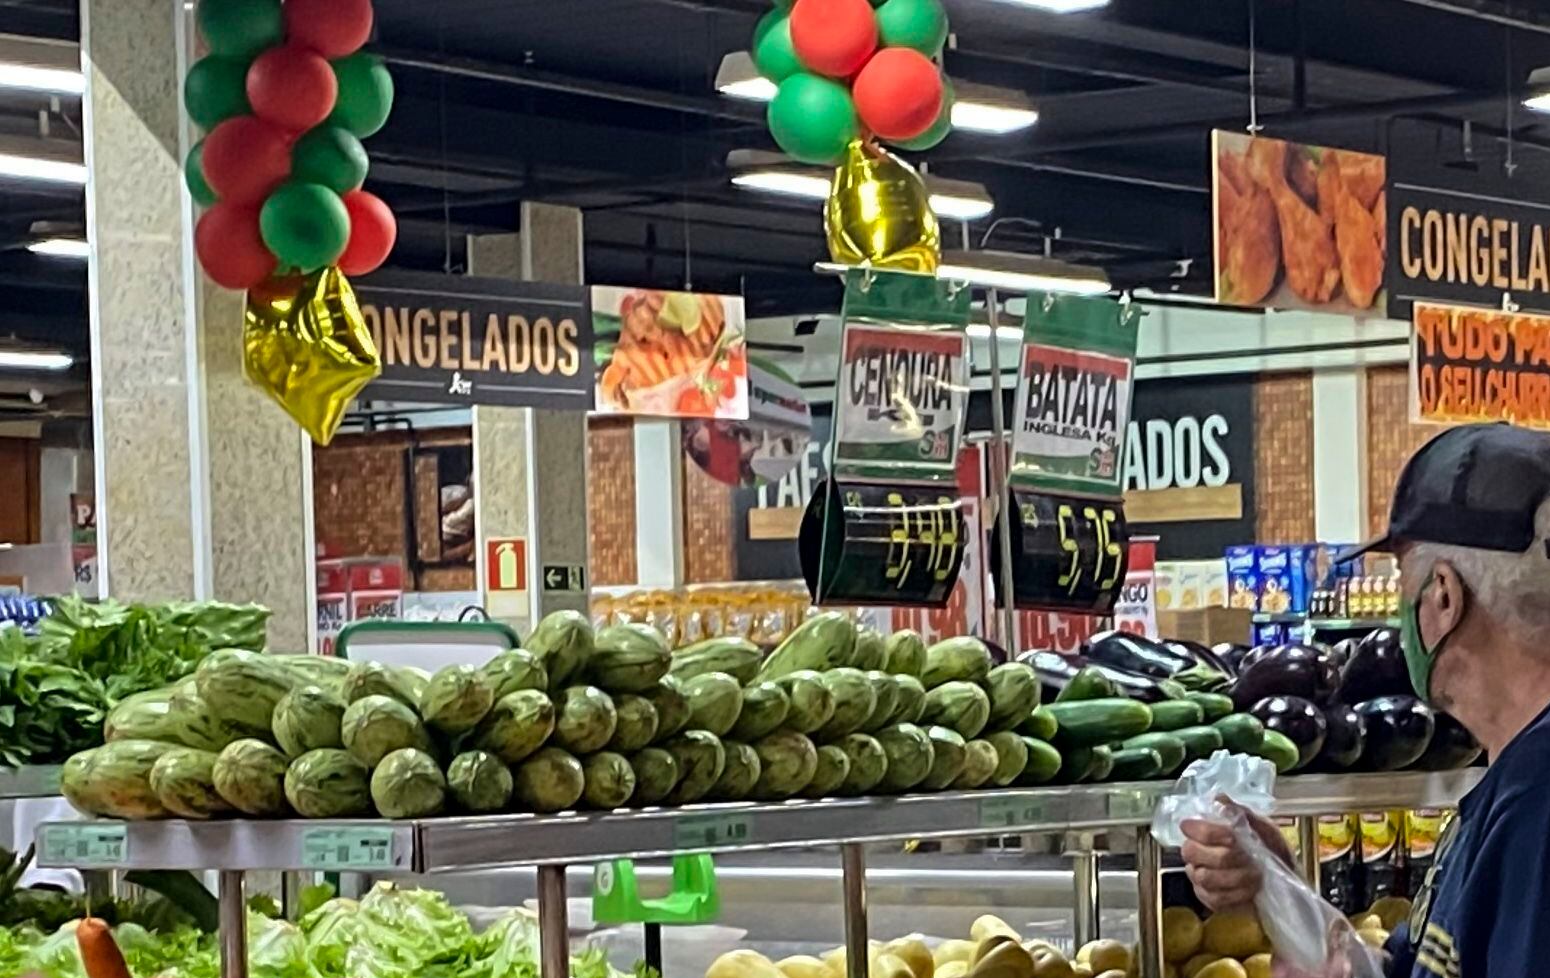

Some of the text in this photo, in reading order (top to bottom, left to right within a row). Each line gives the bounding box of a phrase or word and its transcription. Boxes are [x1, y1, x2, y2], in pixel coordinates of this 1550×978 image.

[361, 304, 580, 377] ONGELADOS
[1416, 309, 1507, 364] TUDO
[850, 347, 951, 411] CENOURA
[1025, 361, 1118, 432] BATATA
[1421, 362, 1435, 413] O
[1437, 364, 1482, 417] SEU
[1024, 419, 1090, 443] INGLESA
[1122, 413, 1231, 491] ADOS
